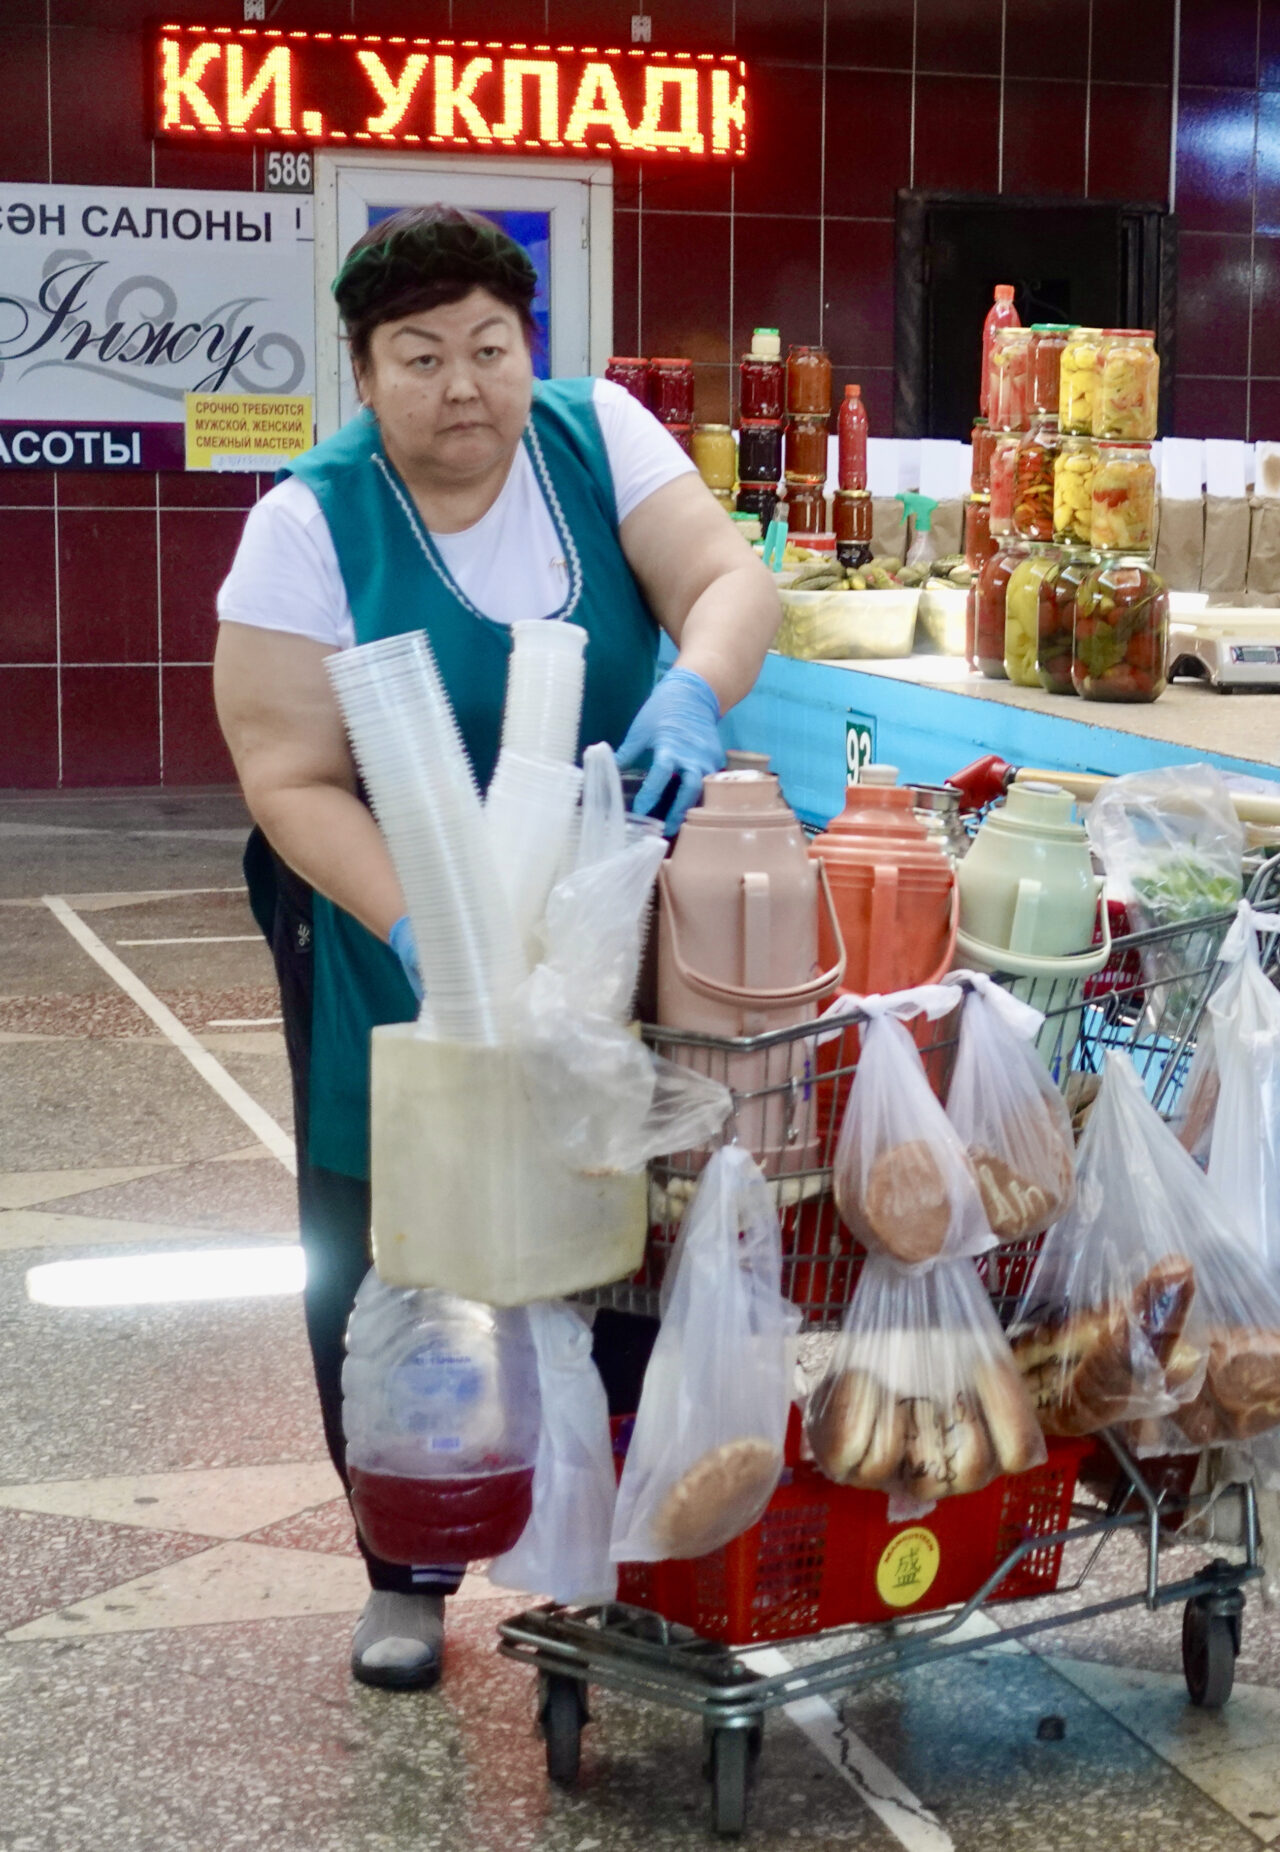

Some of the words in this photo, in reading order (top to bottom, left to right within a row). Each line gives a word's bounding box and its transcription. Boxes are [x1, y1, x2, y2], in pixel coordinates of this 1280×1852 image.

[268, 151, 310, 186] 586
[0, 203, 65, 236] ӘН
[81, 205, 271, 243] САЛОНЫ
[196, 401, 239, 415] СРОЧНО
[242, 402, 304, 416] ТРЕБУЮТСЯ
[196, 435, 250, 448] СМЕЖНЫЙ
[254, 438, 304, 449] МАСТЕРА!
